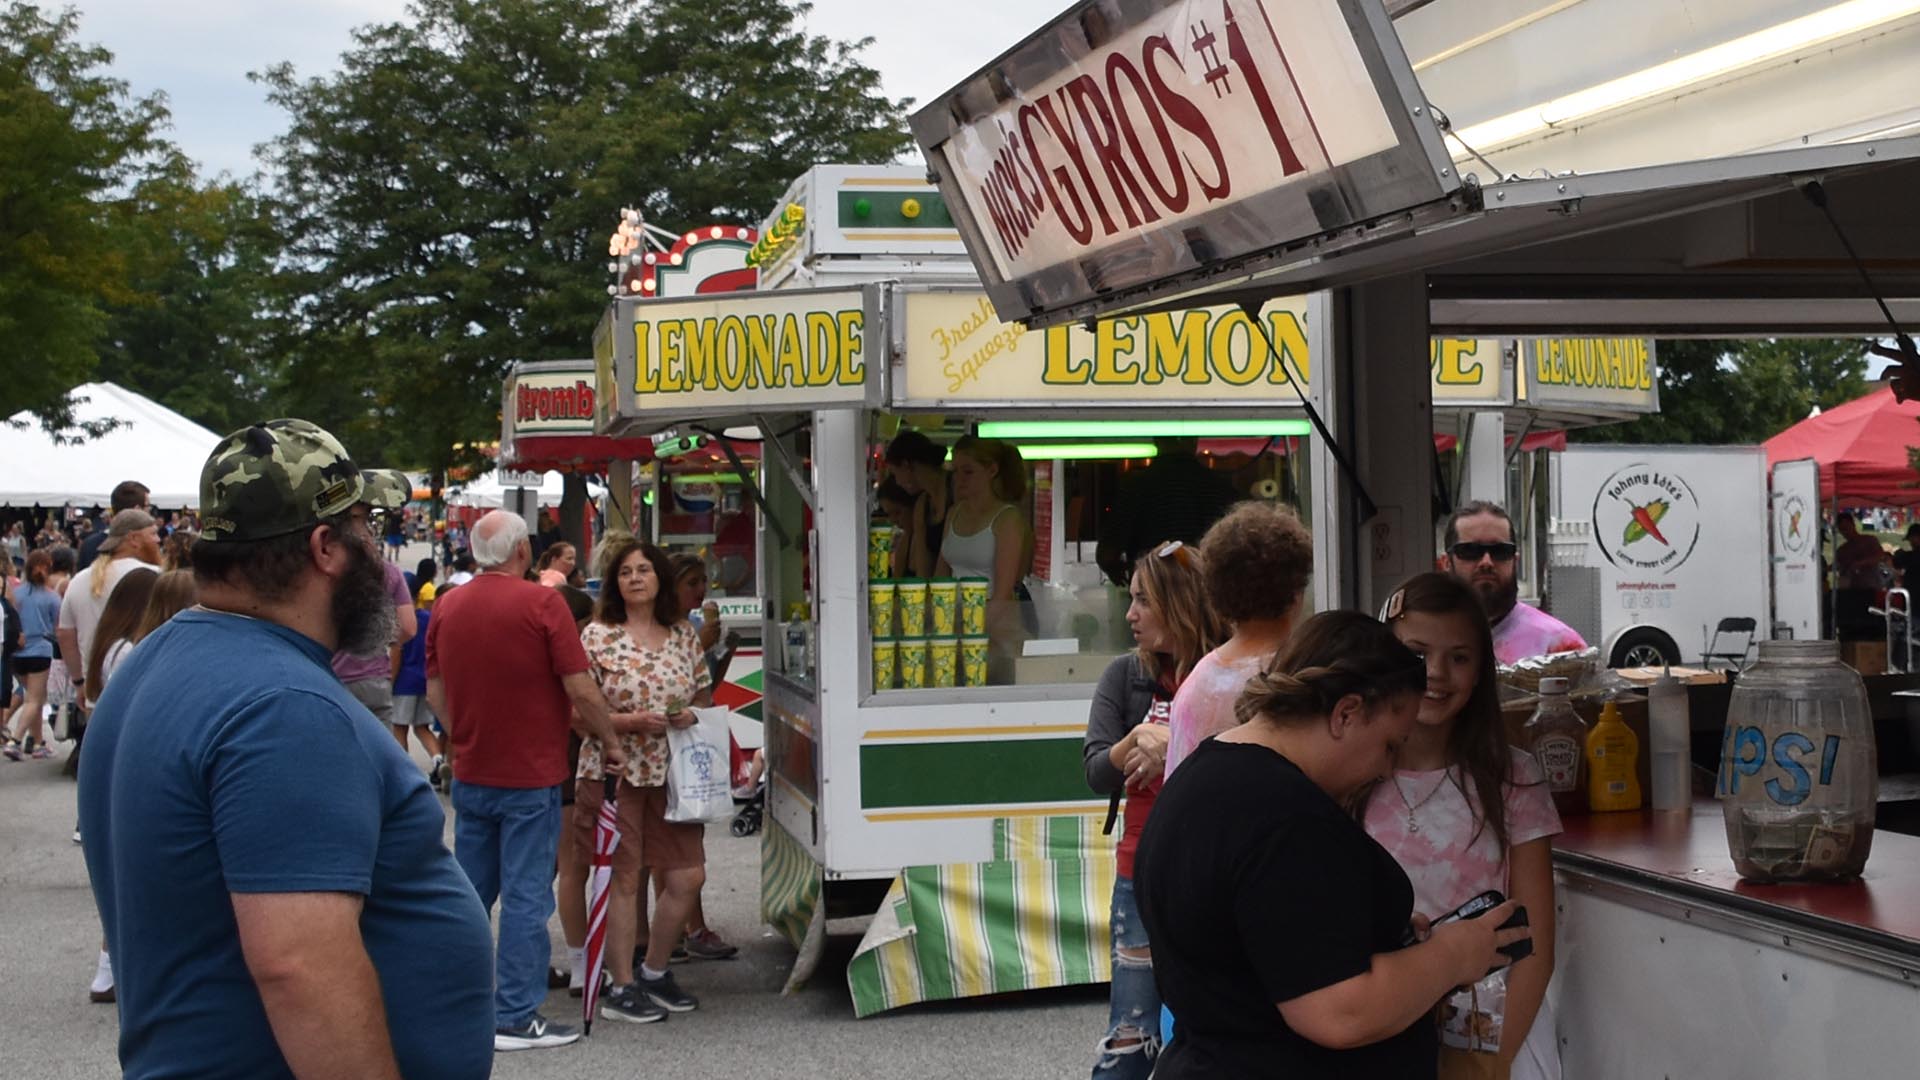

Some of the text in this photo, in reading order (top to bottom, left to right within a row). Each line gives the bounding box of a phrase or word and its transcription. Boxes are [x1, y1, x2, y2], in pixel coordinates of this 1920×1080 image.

[1018, 32, 1231, 246] GYROS
[633, 310, 866, 393] LEMONADE
[930, 296, 996, 361] Fresh
[943, 320, 1028, 394] Squeeze
[1536, 338, 1651, 390] LEMONADE
[1608, 473, 1650, 501] Johnny
